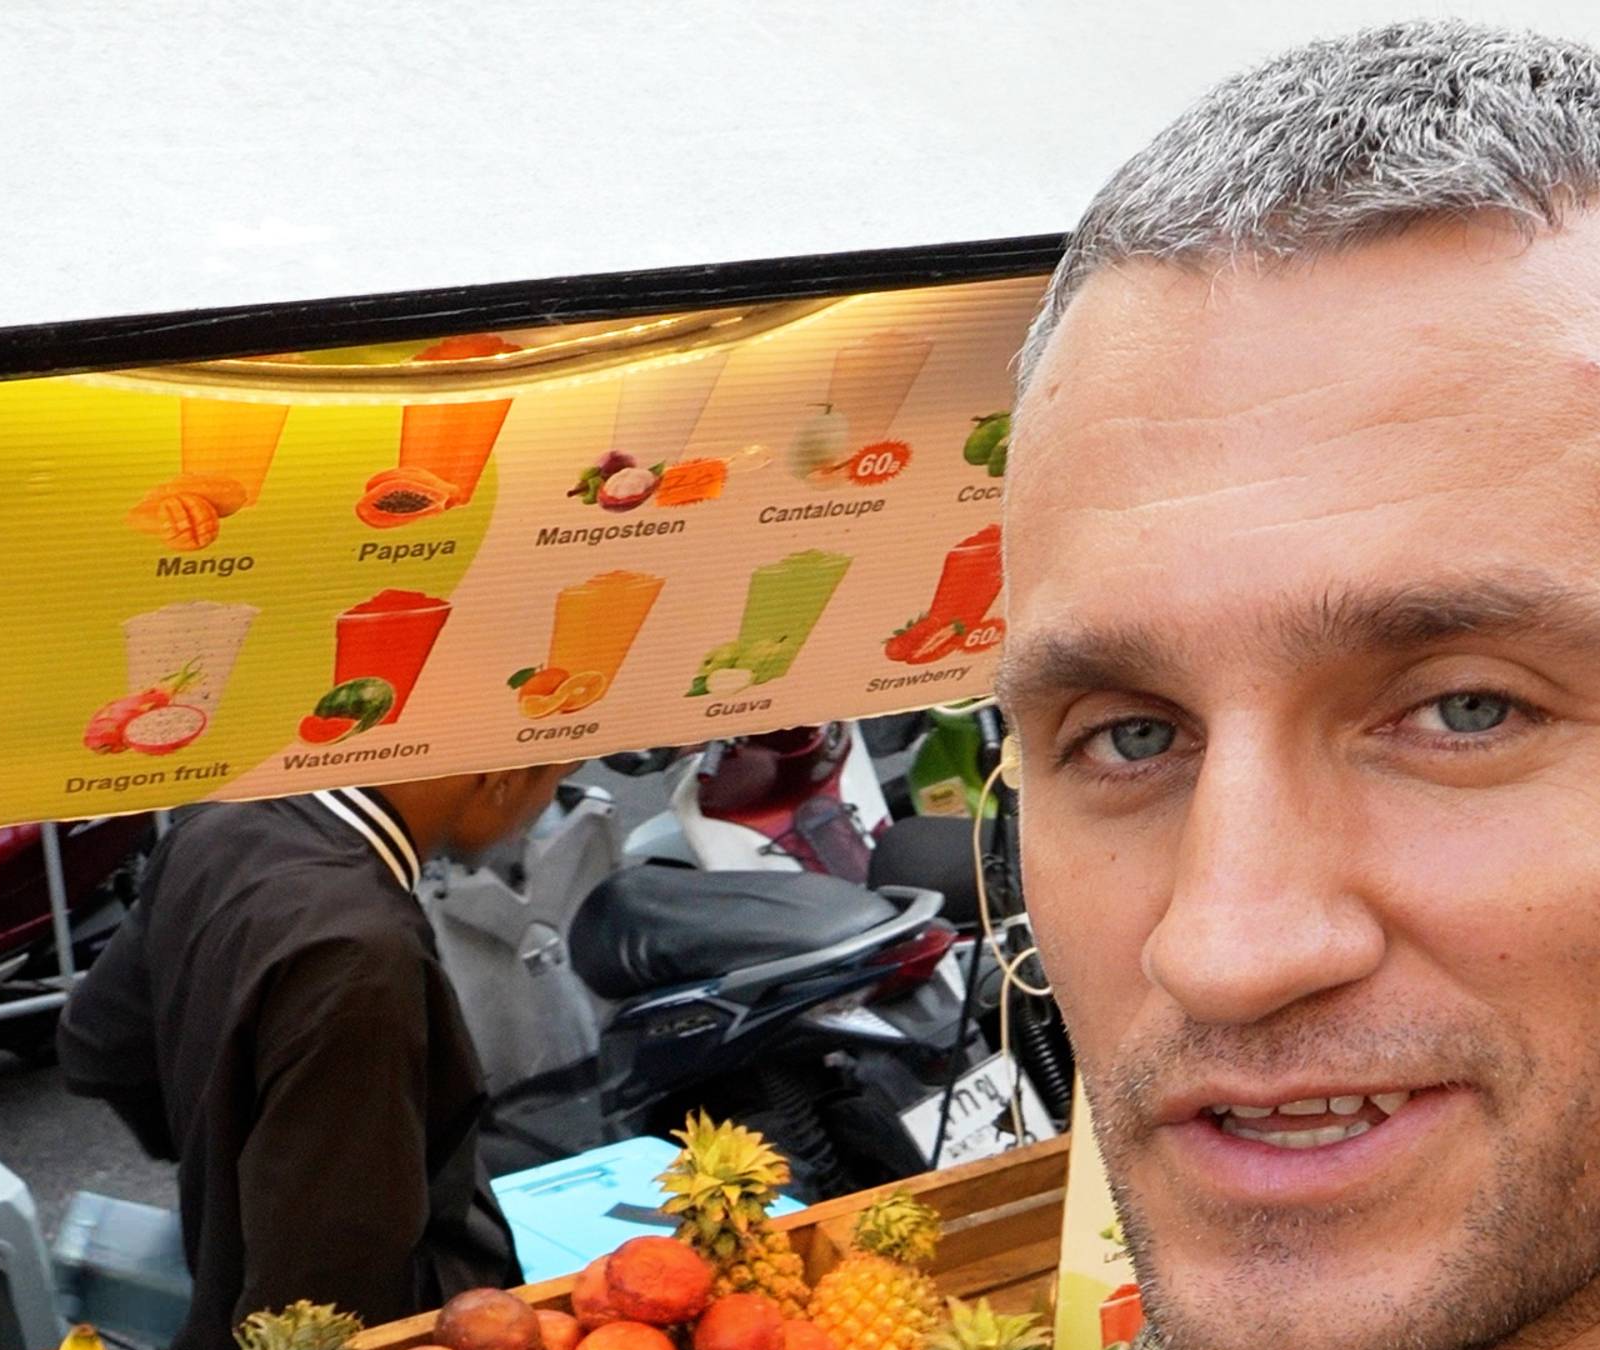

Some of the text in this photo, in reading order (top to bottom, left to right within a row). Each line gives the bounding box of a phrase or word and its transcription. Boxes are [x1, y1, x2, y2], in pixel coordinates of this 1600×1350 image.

[957, 485, 1002, 503] Coc
[758, 499, 885, 525] Cantaloupe
[535, 519, 686, 547] Mangosteen
[358, 539, 457, 565] Papaya
[155, 554, 255, 578] Mango
[866, 665, 972, 693] Strawberry
[705, 698, 772, 718] Guava
[516, 722, 599, 743] Orange
[282, 741, 430, 771] Watermelon
[64, 761, 231, 794] Dragon fruit
